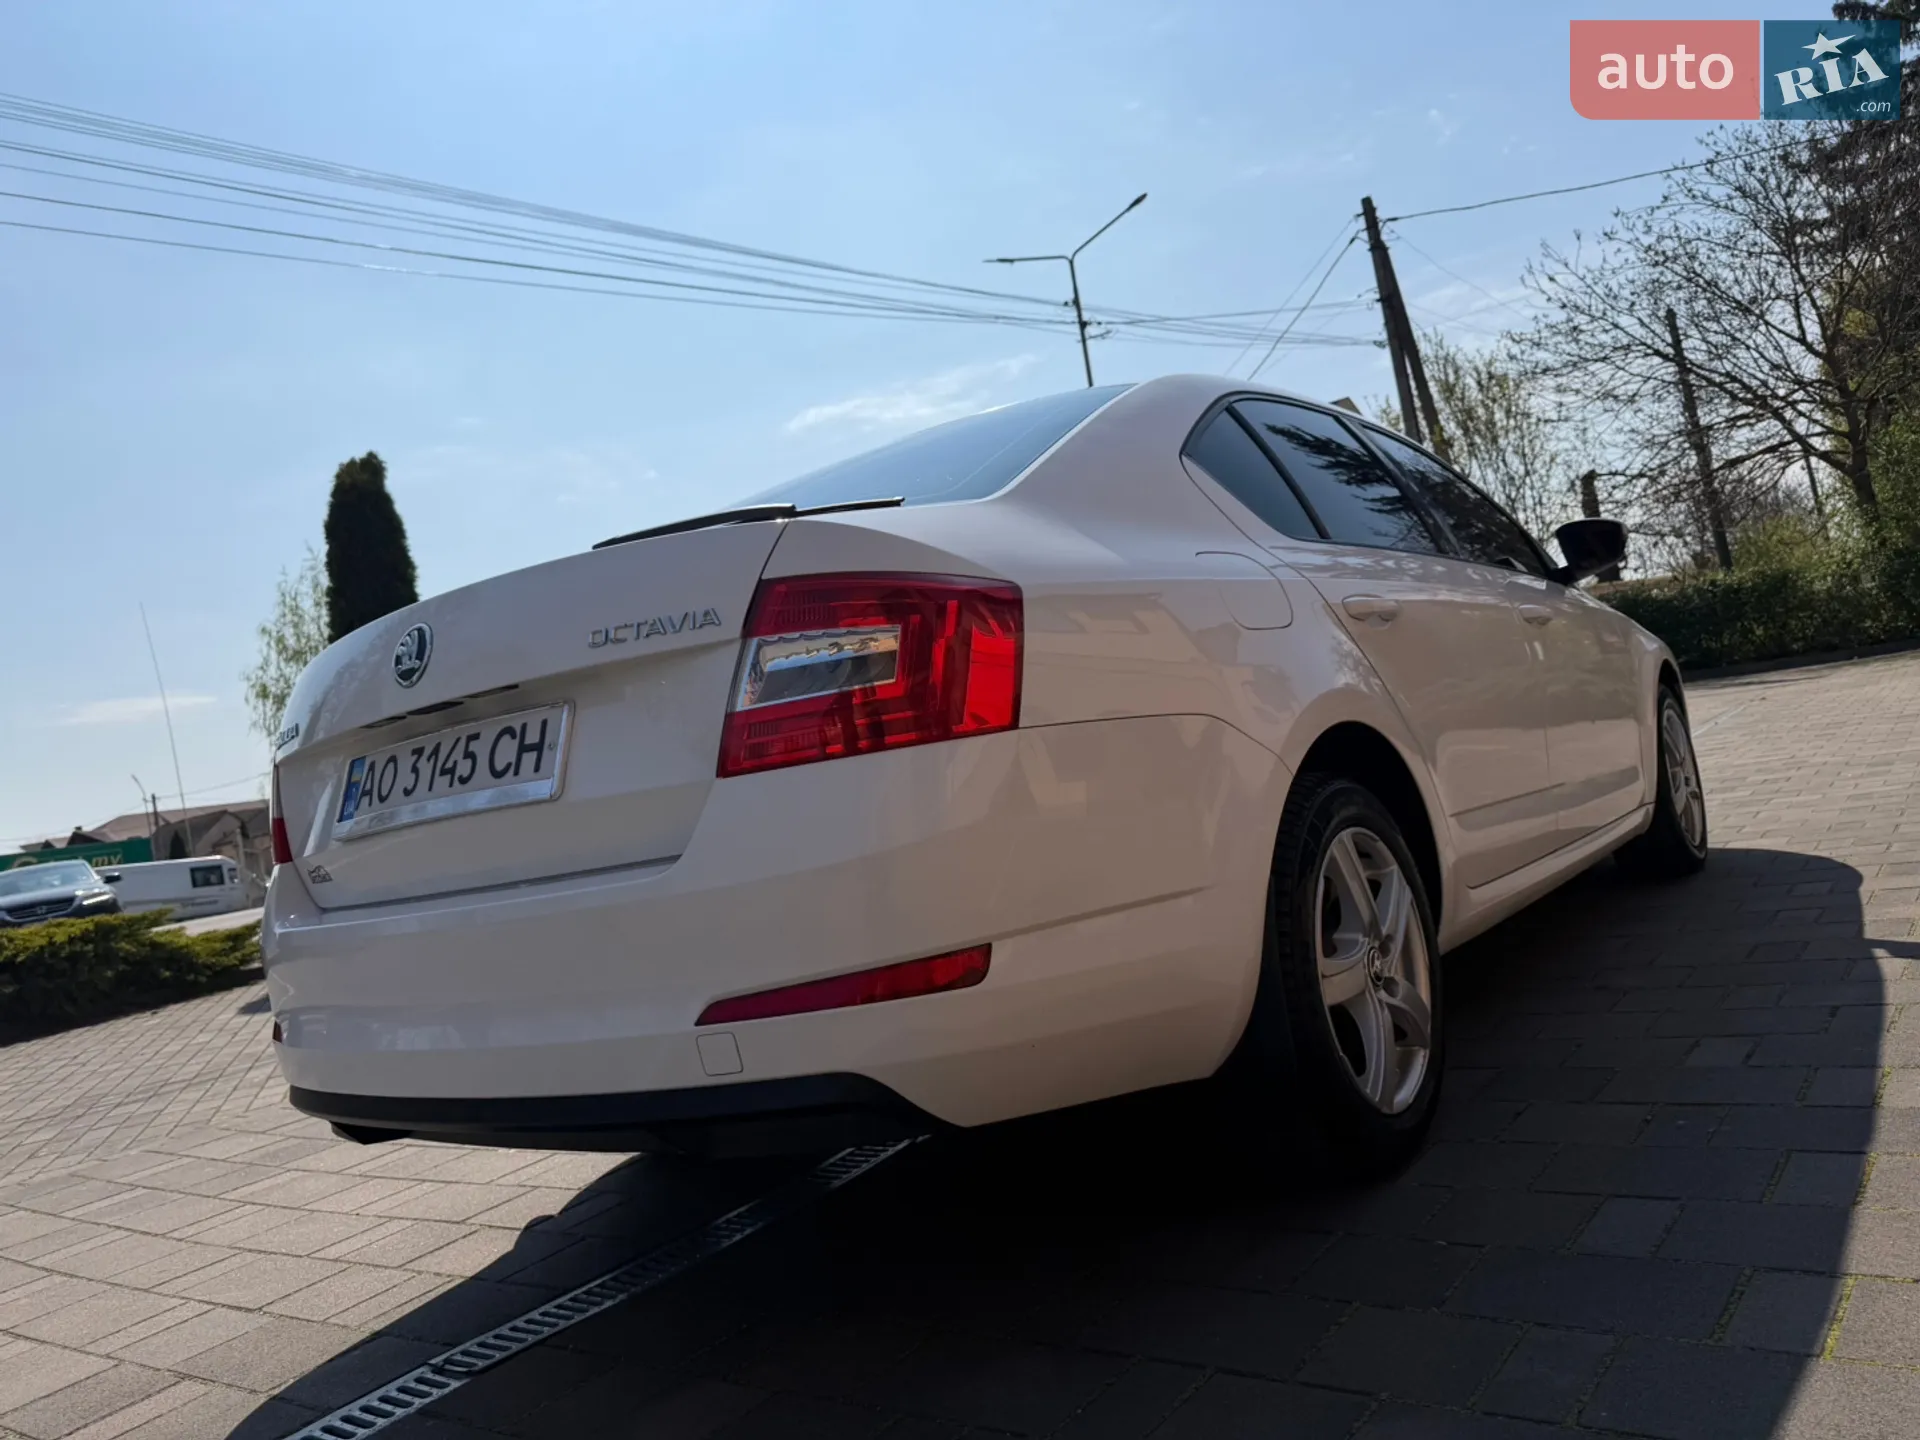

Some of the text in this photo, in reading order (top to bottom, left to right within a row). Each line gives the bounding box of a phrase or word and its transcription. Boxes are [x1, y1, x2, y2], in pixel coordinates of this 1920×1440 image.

[588, 609, 721, 648] OCTAVIA
[355, 718, 548, 810] AO 3145 CH
